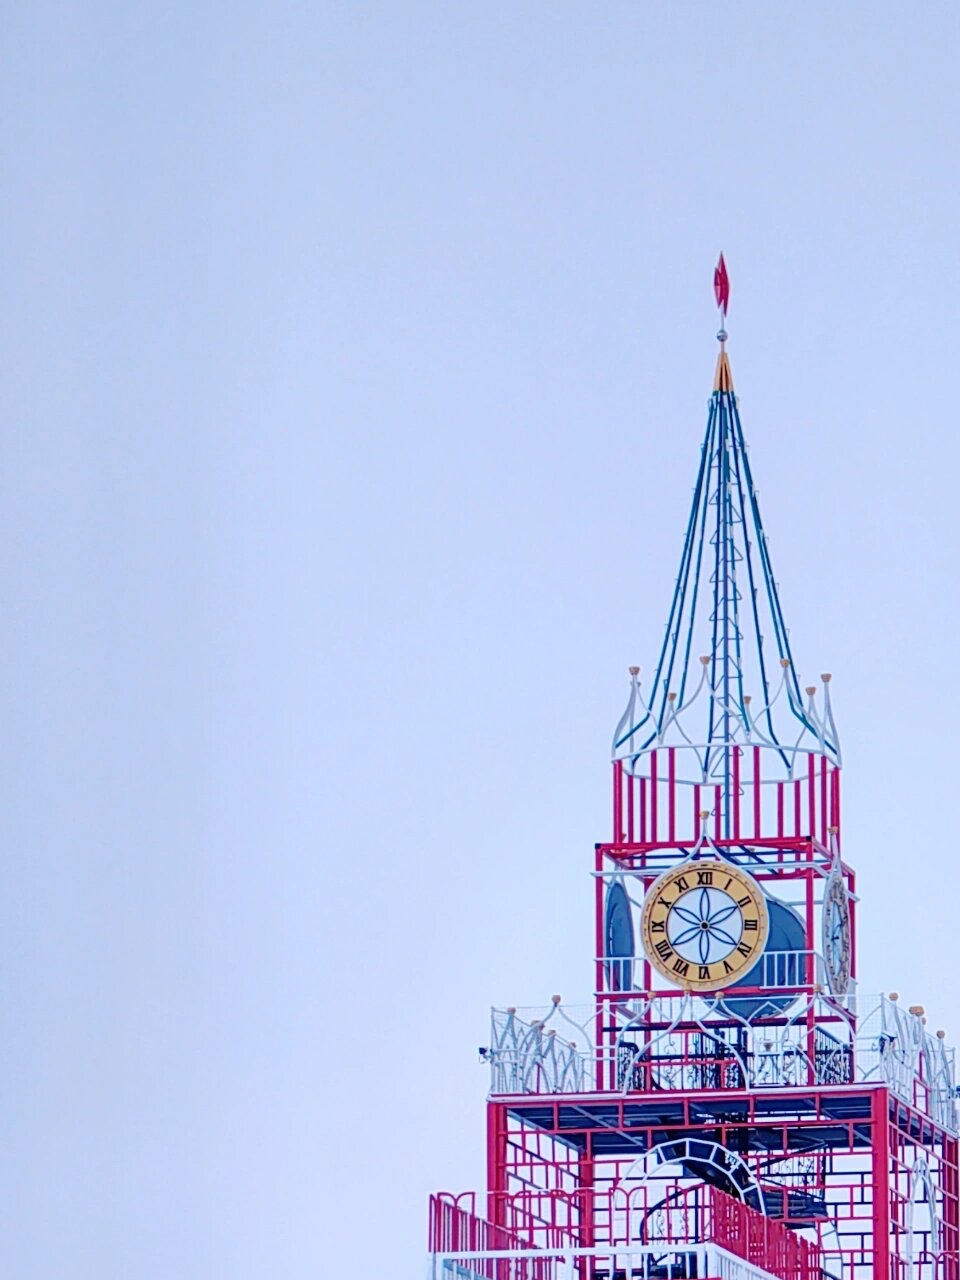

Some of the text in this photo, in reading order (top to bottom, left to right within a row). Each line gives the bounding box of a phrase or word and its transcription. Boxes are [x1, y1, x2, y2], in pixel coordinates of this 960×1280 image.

[674, 876, 690, 893] XI
[696, 871, 713, 885] XII
[724, 878, 733, 891] I
[657, 897, 672, 909] X
[737, 895, 752, 909] II
[652, 920, 665, 933] IX
[744, 919, 758, 931] III
[654, 939, 674, 962] VIII
[737, 941, 752, 958] IV
[672, 959, 690, 977] VII
[698, 966, 711, 980] VI
[723, 960, 734, 974] V
